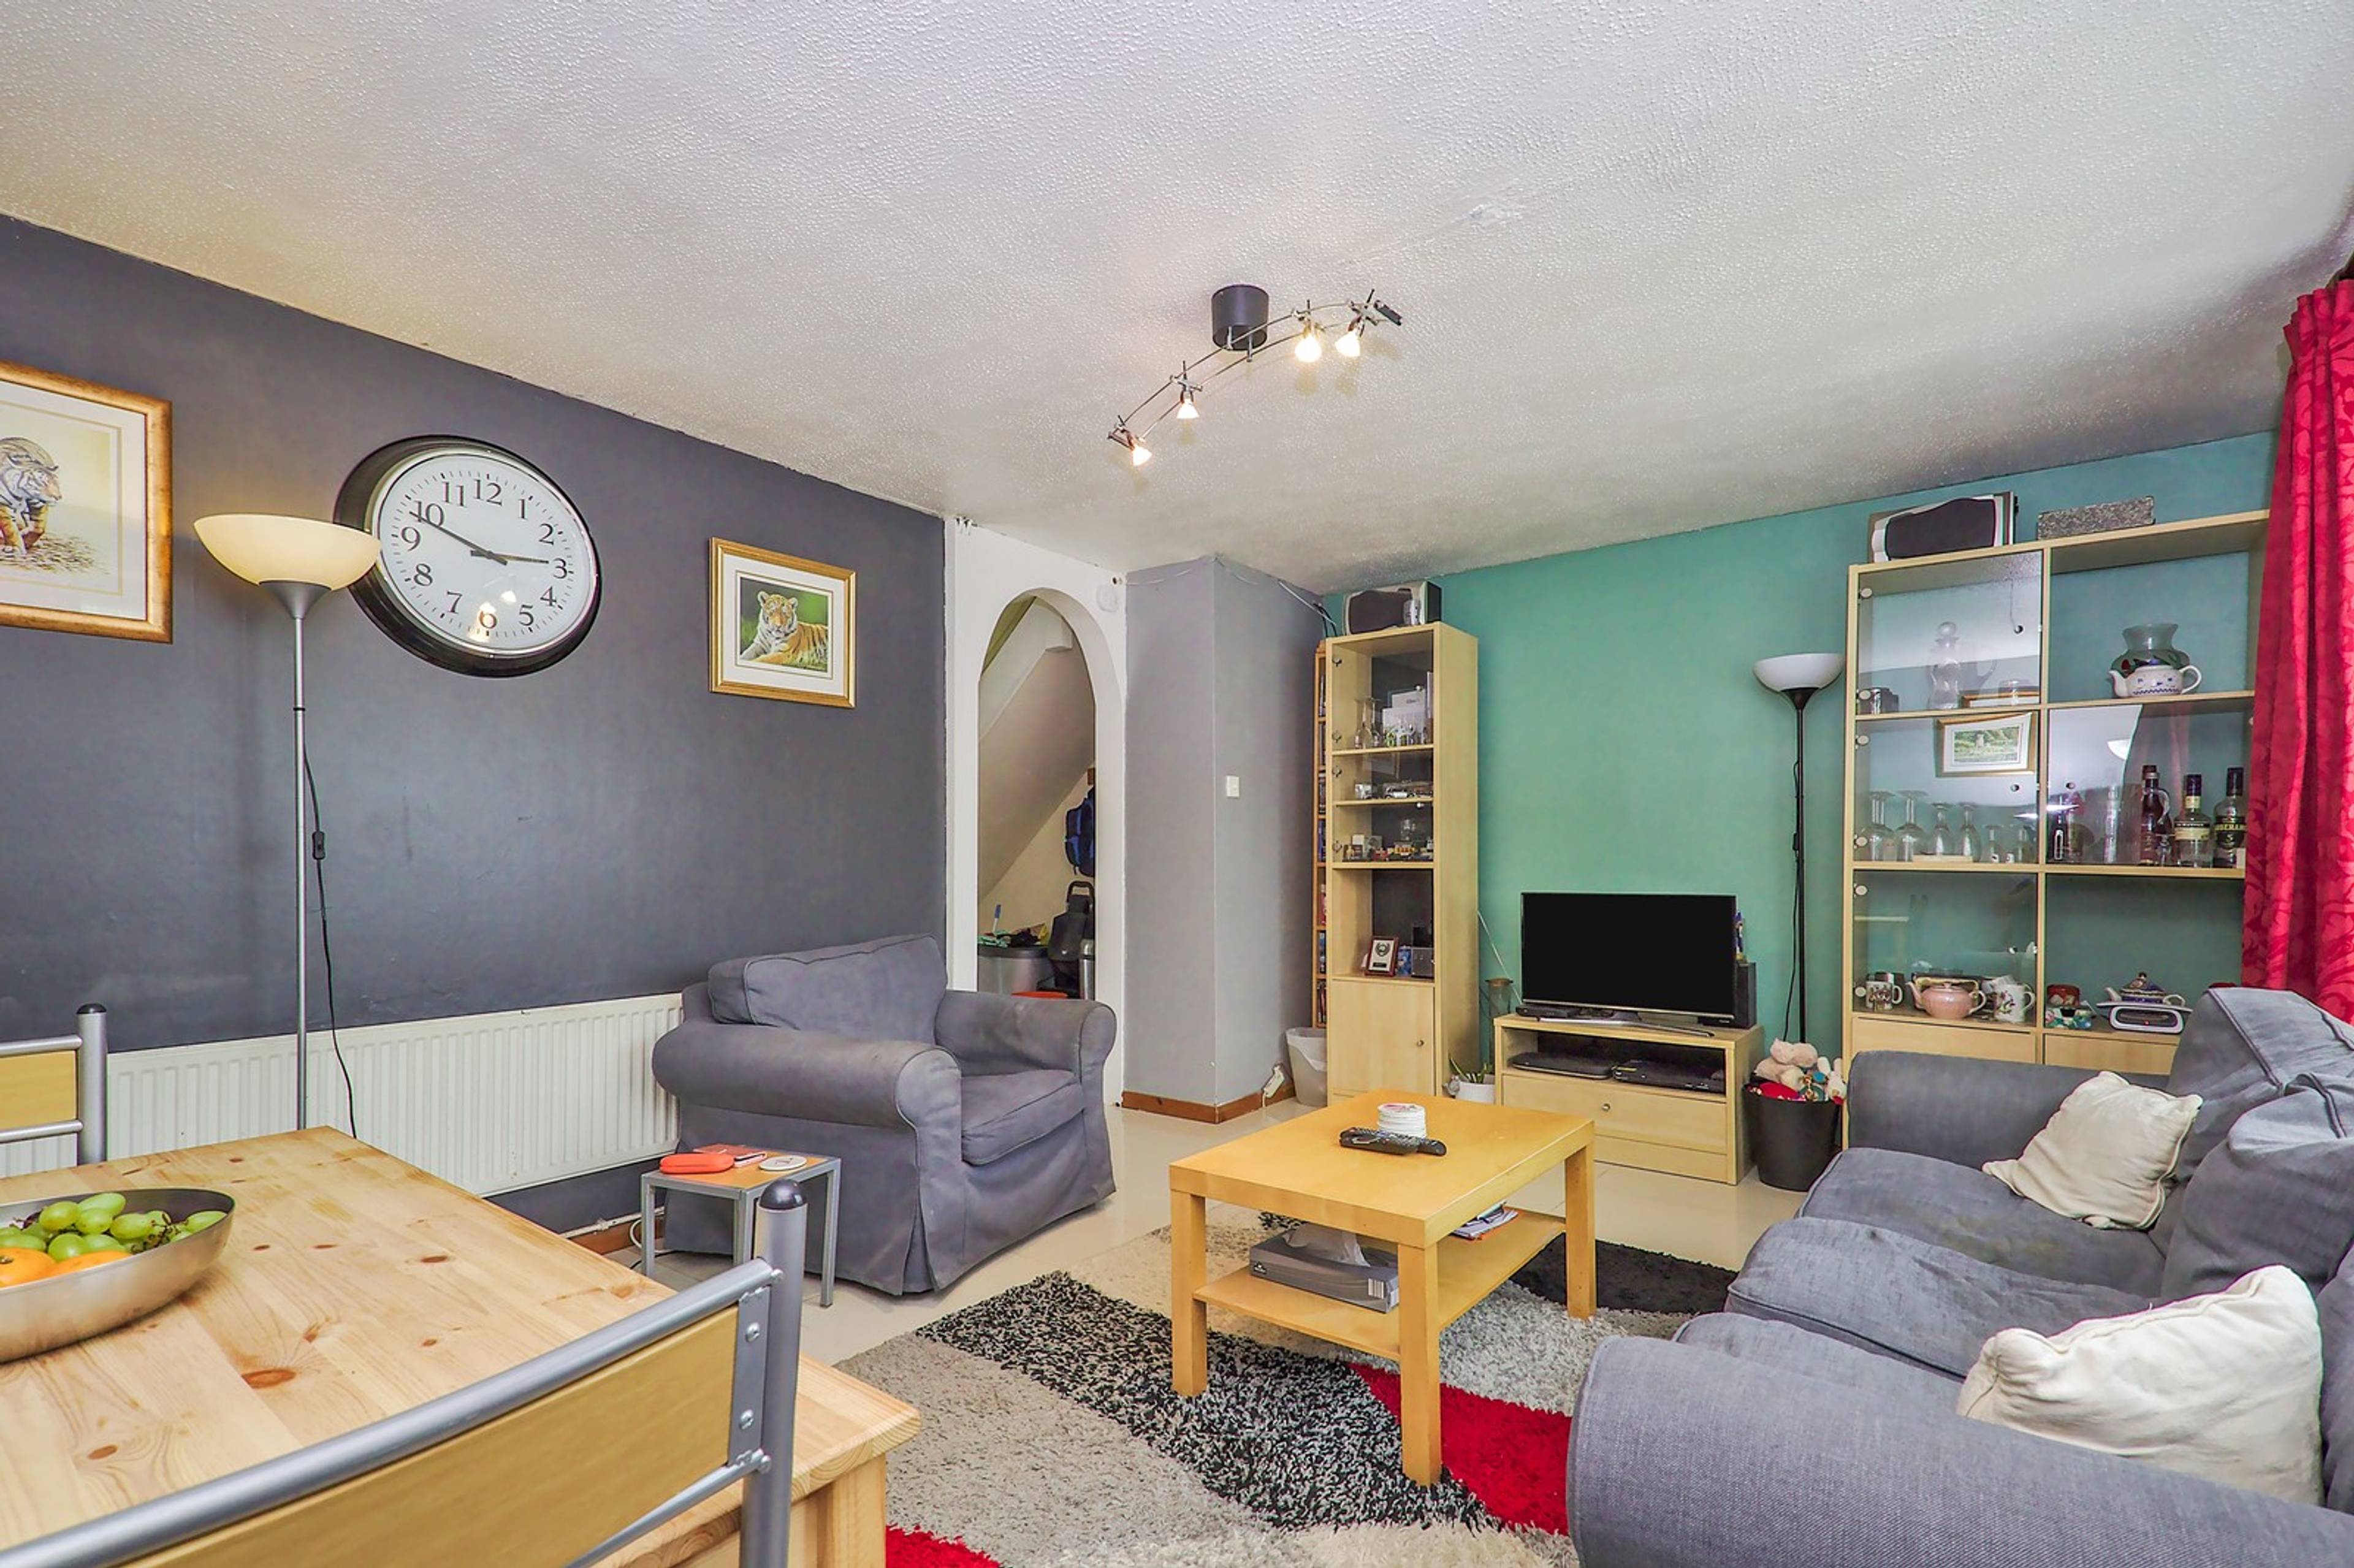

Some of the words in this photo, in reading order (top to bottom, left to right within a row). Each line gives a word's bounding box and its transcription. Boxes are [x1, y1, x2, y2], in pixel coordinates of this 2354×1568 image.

[442, 481, 468, 508] 11
[474, 479, 503, 506] 12
[414, 500, 445, 527] 10
[518, 498, 528, 520] 1
[400, 526, 422, 552] 9
[539, 523, 555, 546] 2
[413, 563, 433, 587] 8
[552, 558, 568, 579] 3
[446, 590, 463, 614] 7
[539, 585, 557, 607] 4
[479, 607, 498, 630] 6
[518, 604, 535, 626] 5
